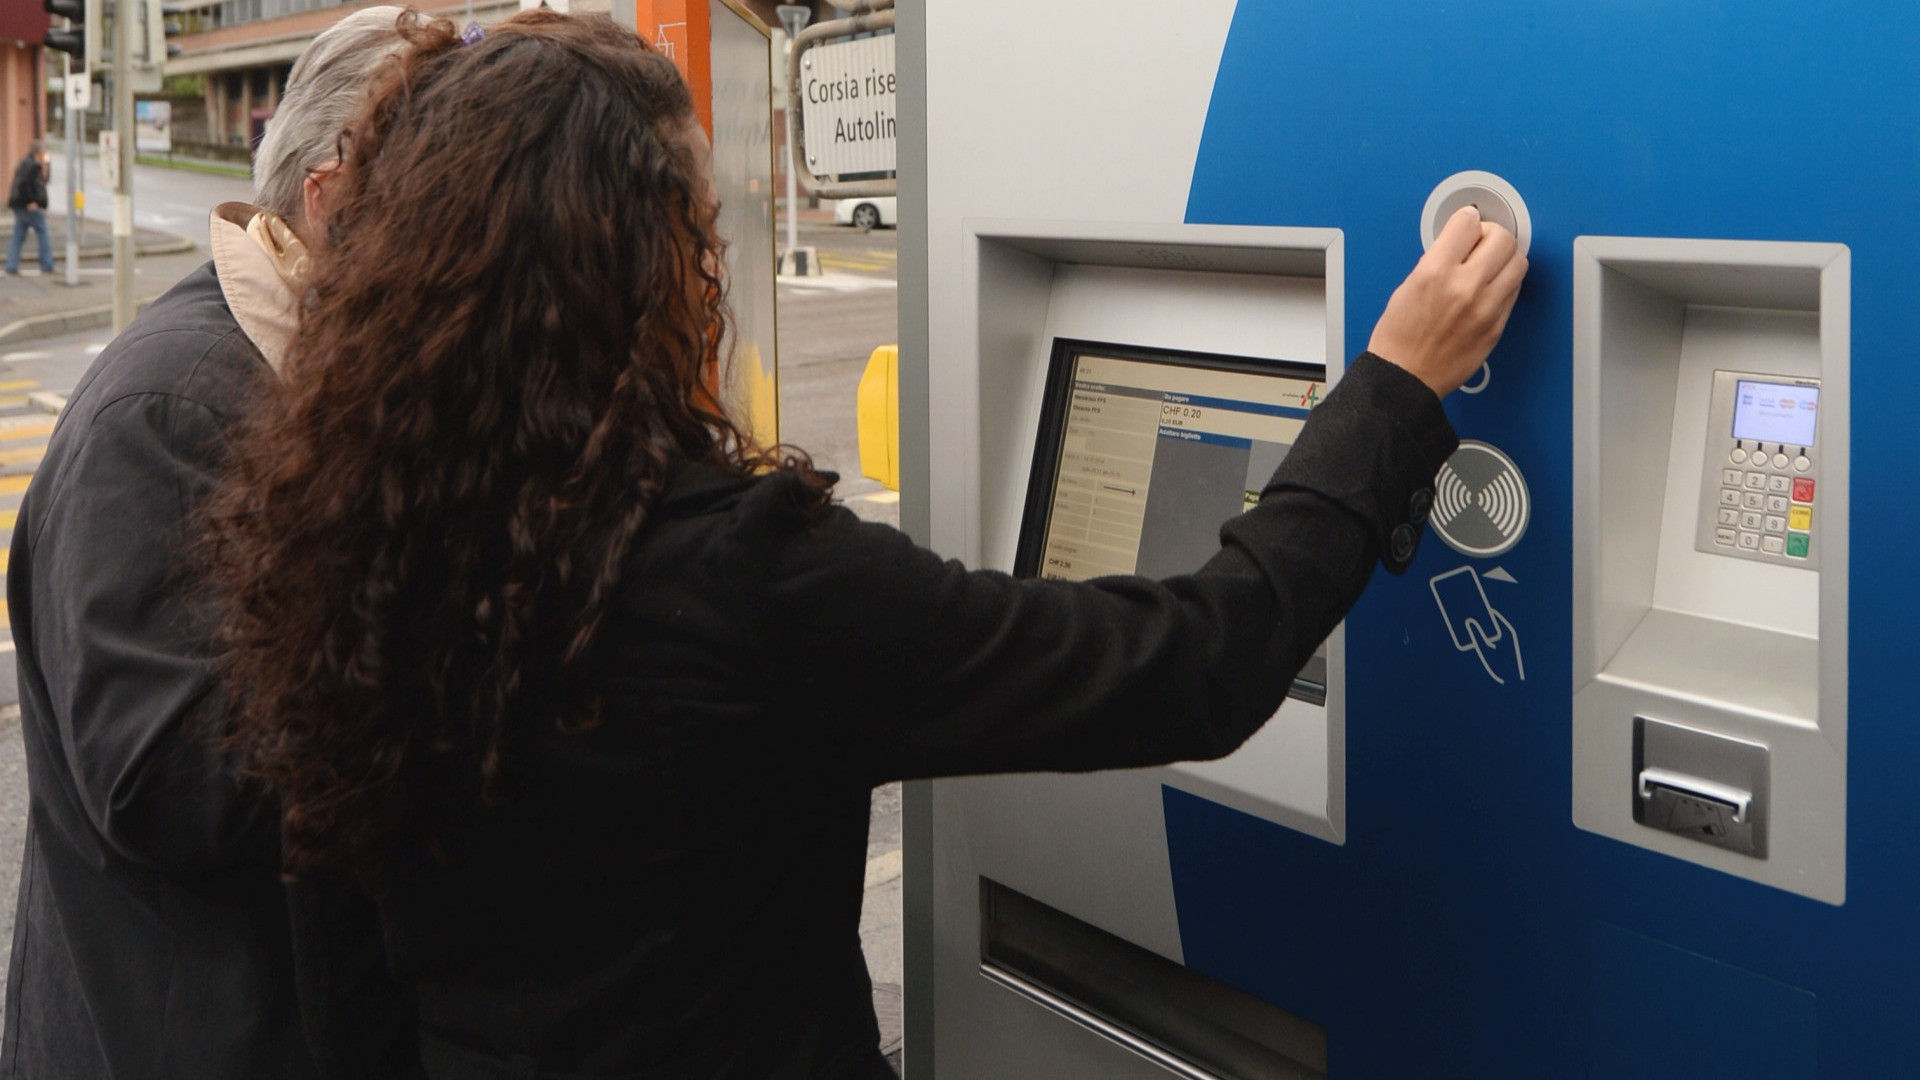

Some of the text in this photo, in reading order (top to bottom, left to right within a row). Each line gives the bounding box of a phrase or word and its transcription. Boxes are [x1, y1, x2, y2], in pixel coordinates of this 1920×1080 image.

[808, 69, 896, 104] Corsia rise
[835, 111, 896, 144] Autolin
[1164, 393, 1172, 401] Da
[1163, 405, 1202, 419] CHF 0.20
[1752, 476, 1759, 486] 2
[1775, 479, 1782, 489] 3
[1726, 493, 1733, 502] 4
[1749, 496, 1756, 506] 5
[1773, 499, 1780, 509] 6
[1724, 513, 1731, 522] 7
[1747, 516, 1754, 526] 8
[1771, 519, 1778, 529] 9
[1745, 536, 1752, 545] 0
